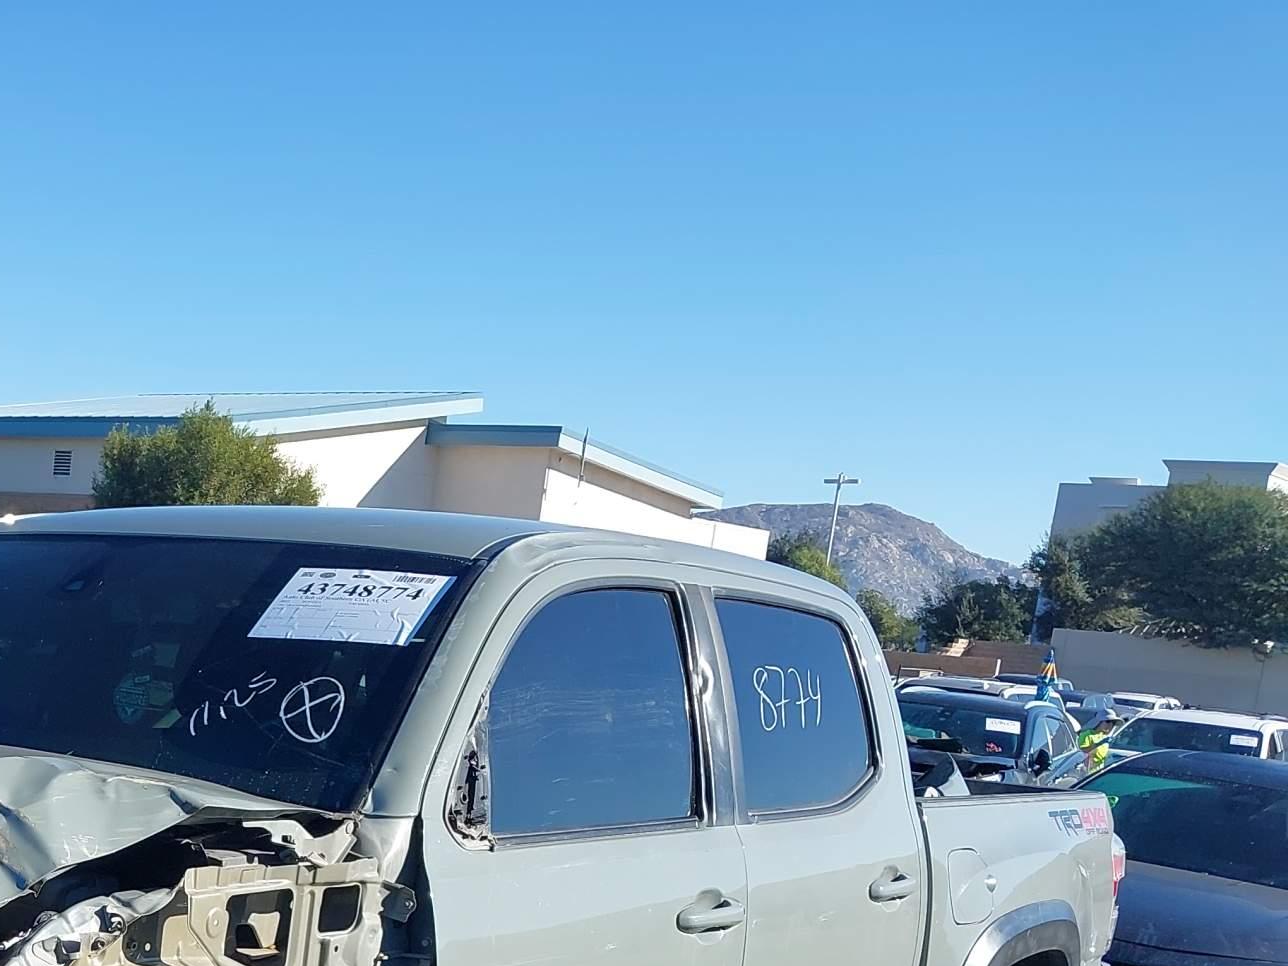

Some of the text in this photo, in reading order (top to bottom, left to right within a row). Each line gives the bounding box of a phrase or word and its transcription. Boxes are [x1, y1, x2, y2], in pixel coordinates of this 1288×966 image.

[298, 582, 425, 600] 43748774
[753, 665, 821, 732] 8774
[1048, 808, 1083, 837] TRD
